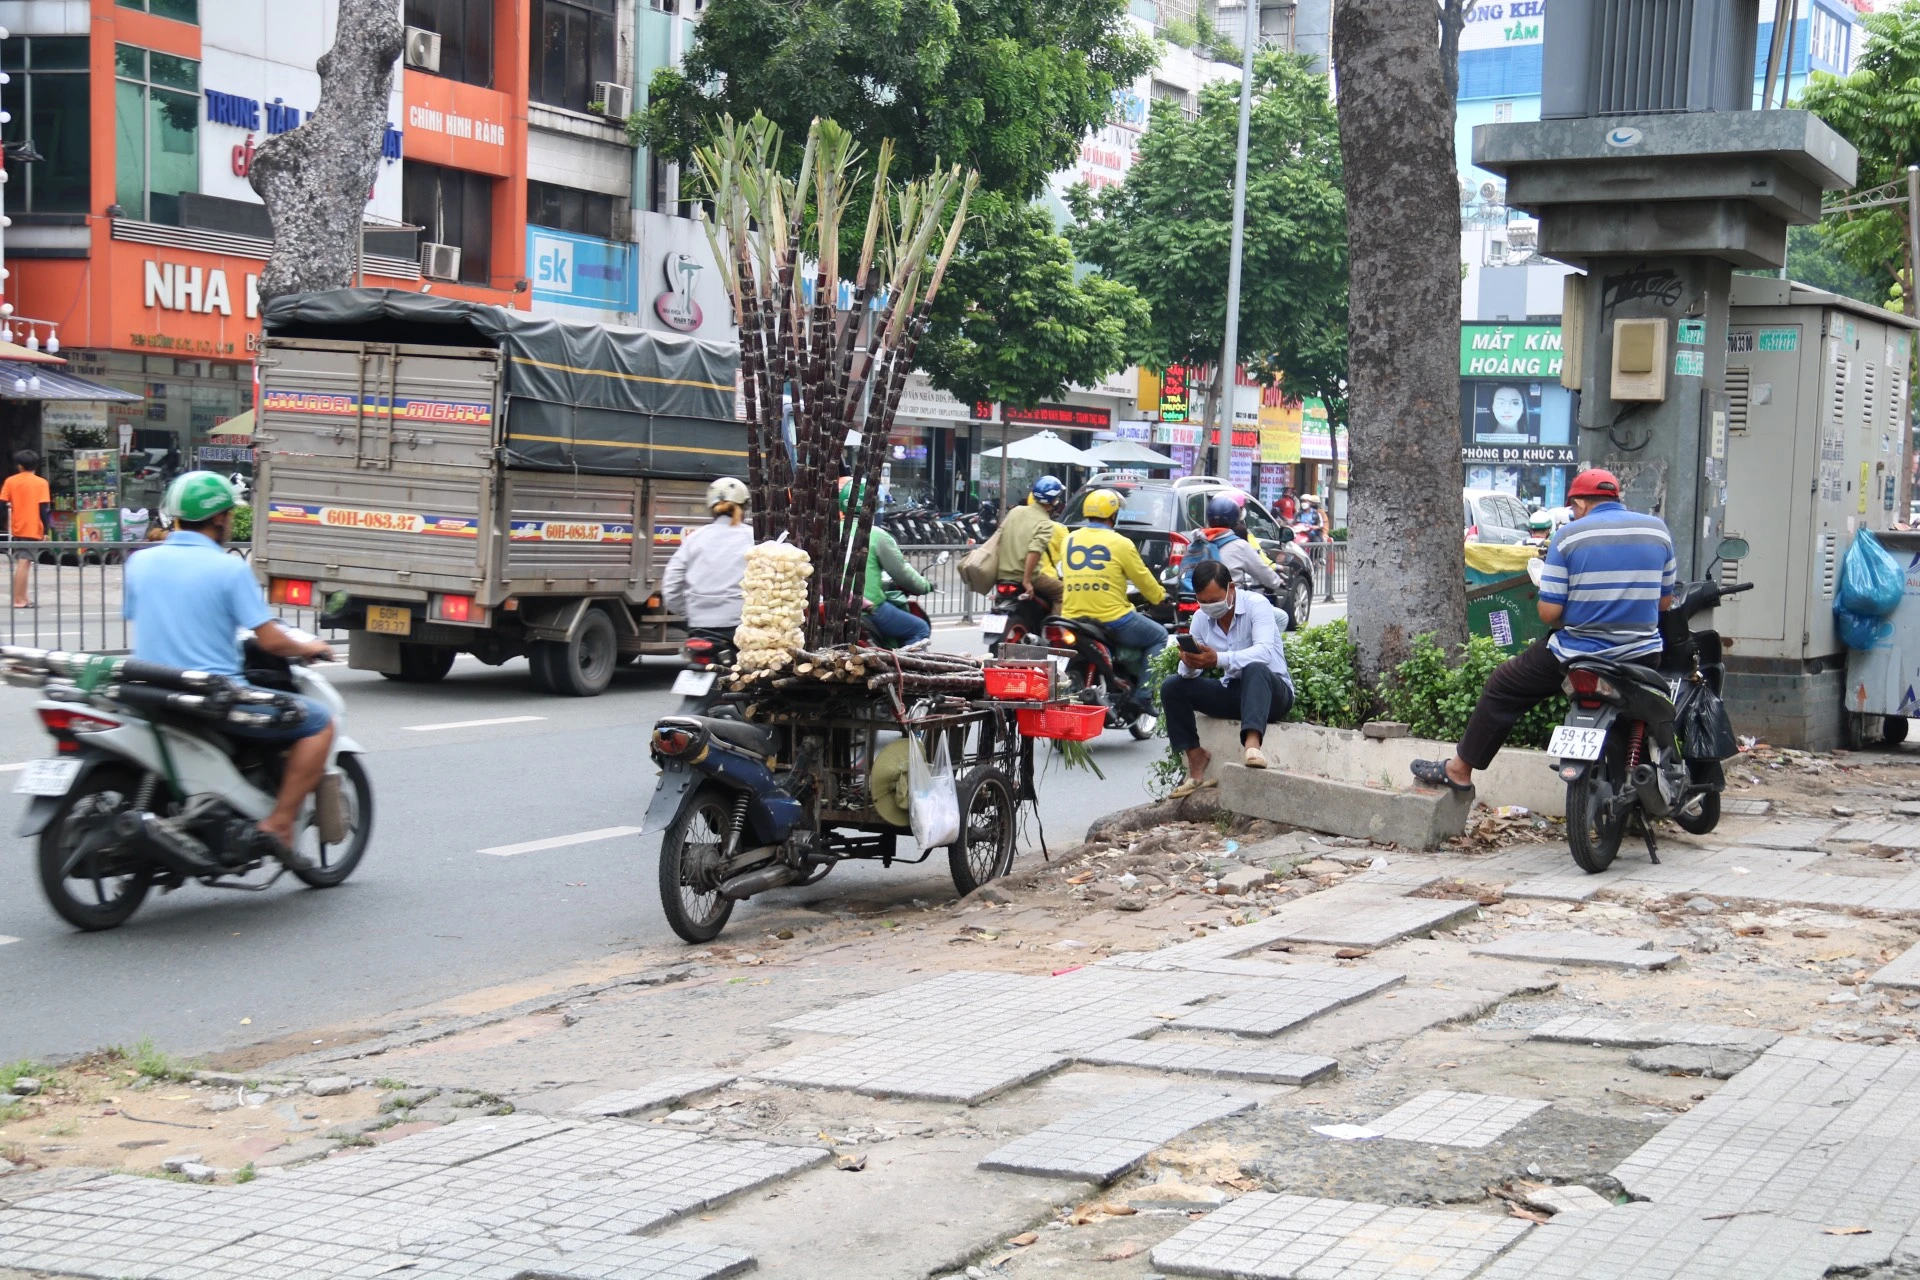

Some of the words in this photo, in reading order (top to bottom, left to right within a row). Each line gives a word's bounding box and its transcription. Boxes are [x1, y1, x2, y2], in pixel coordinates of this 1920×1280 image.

[205, 89, 260, 131] TRUNG
[410, 101, 443, 133] CHỈNH
[446, 110, 472, 139] HÌNH
[475, 117, 505, 146] RĂNG
[539, 248, 567, 284] sk
[144, 259, 232, 317] NHA
[1472, 326, 1514, 350] MẮT
[1524, 331, 1563, 351] KÍN
[1469, 354, 1540, 374] HOÀNG
[268, 392, 351, 412] HYUNDAI
[406, 401, 487, 421] MIGHTY
[1461, 445, 1499, 459] PHÒNG
[1503, 449, 1519, 459] ĐO
[1523, 446, 1555, 460] KHÚC
[1558, 449, 1574, 462] XẠ
[326, 508, 417, 531] 60H-083.37
[545, 521, 600, 541] 60H-083.37
[1067, 537, 1111, 570] be
[1560, 728, 1597, 743] 59-K2
[1551, 742, 1597, 757] 474.17
